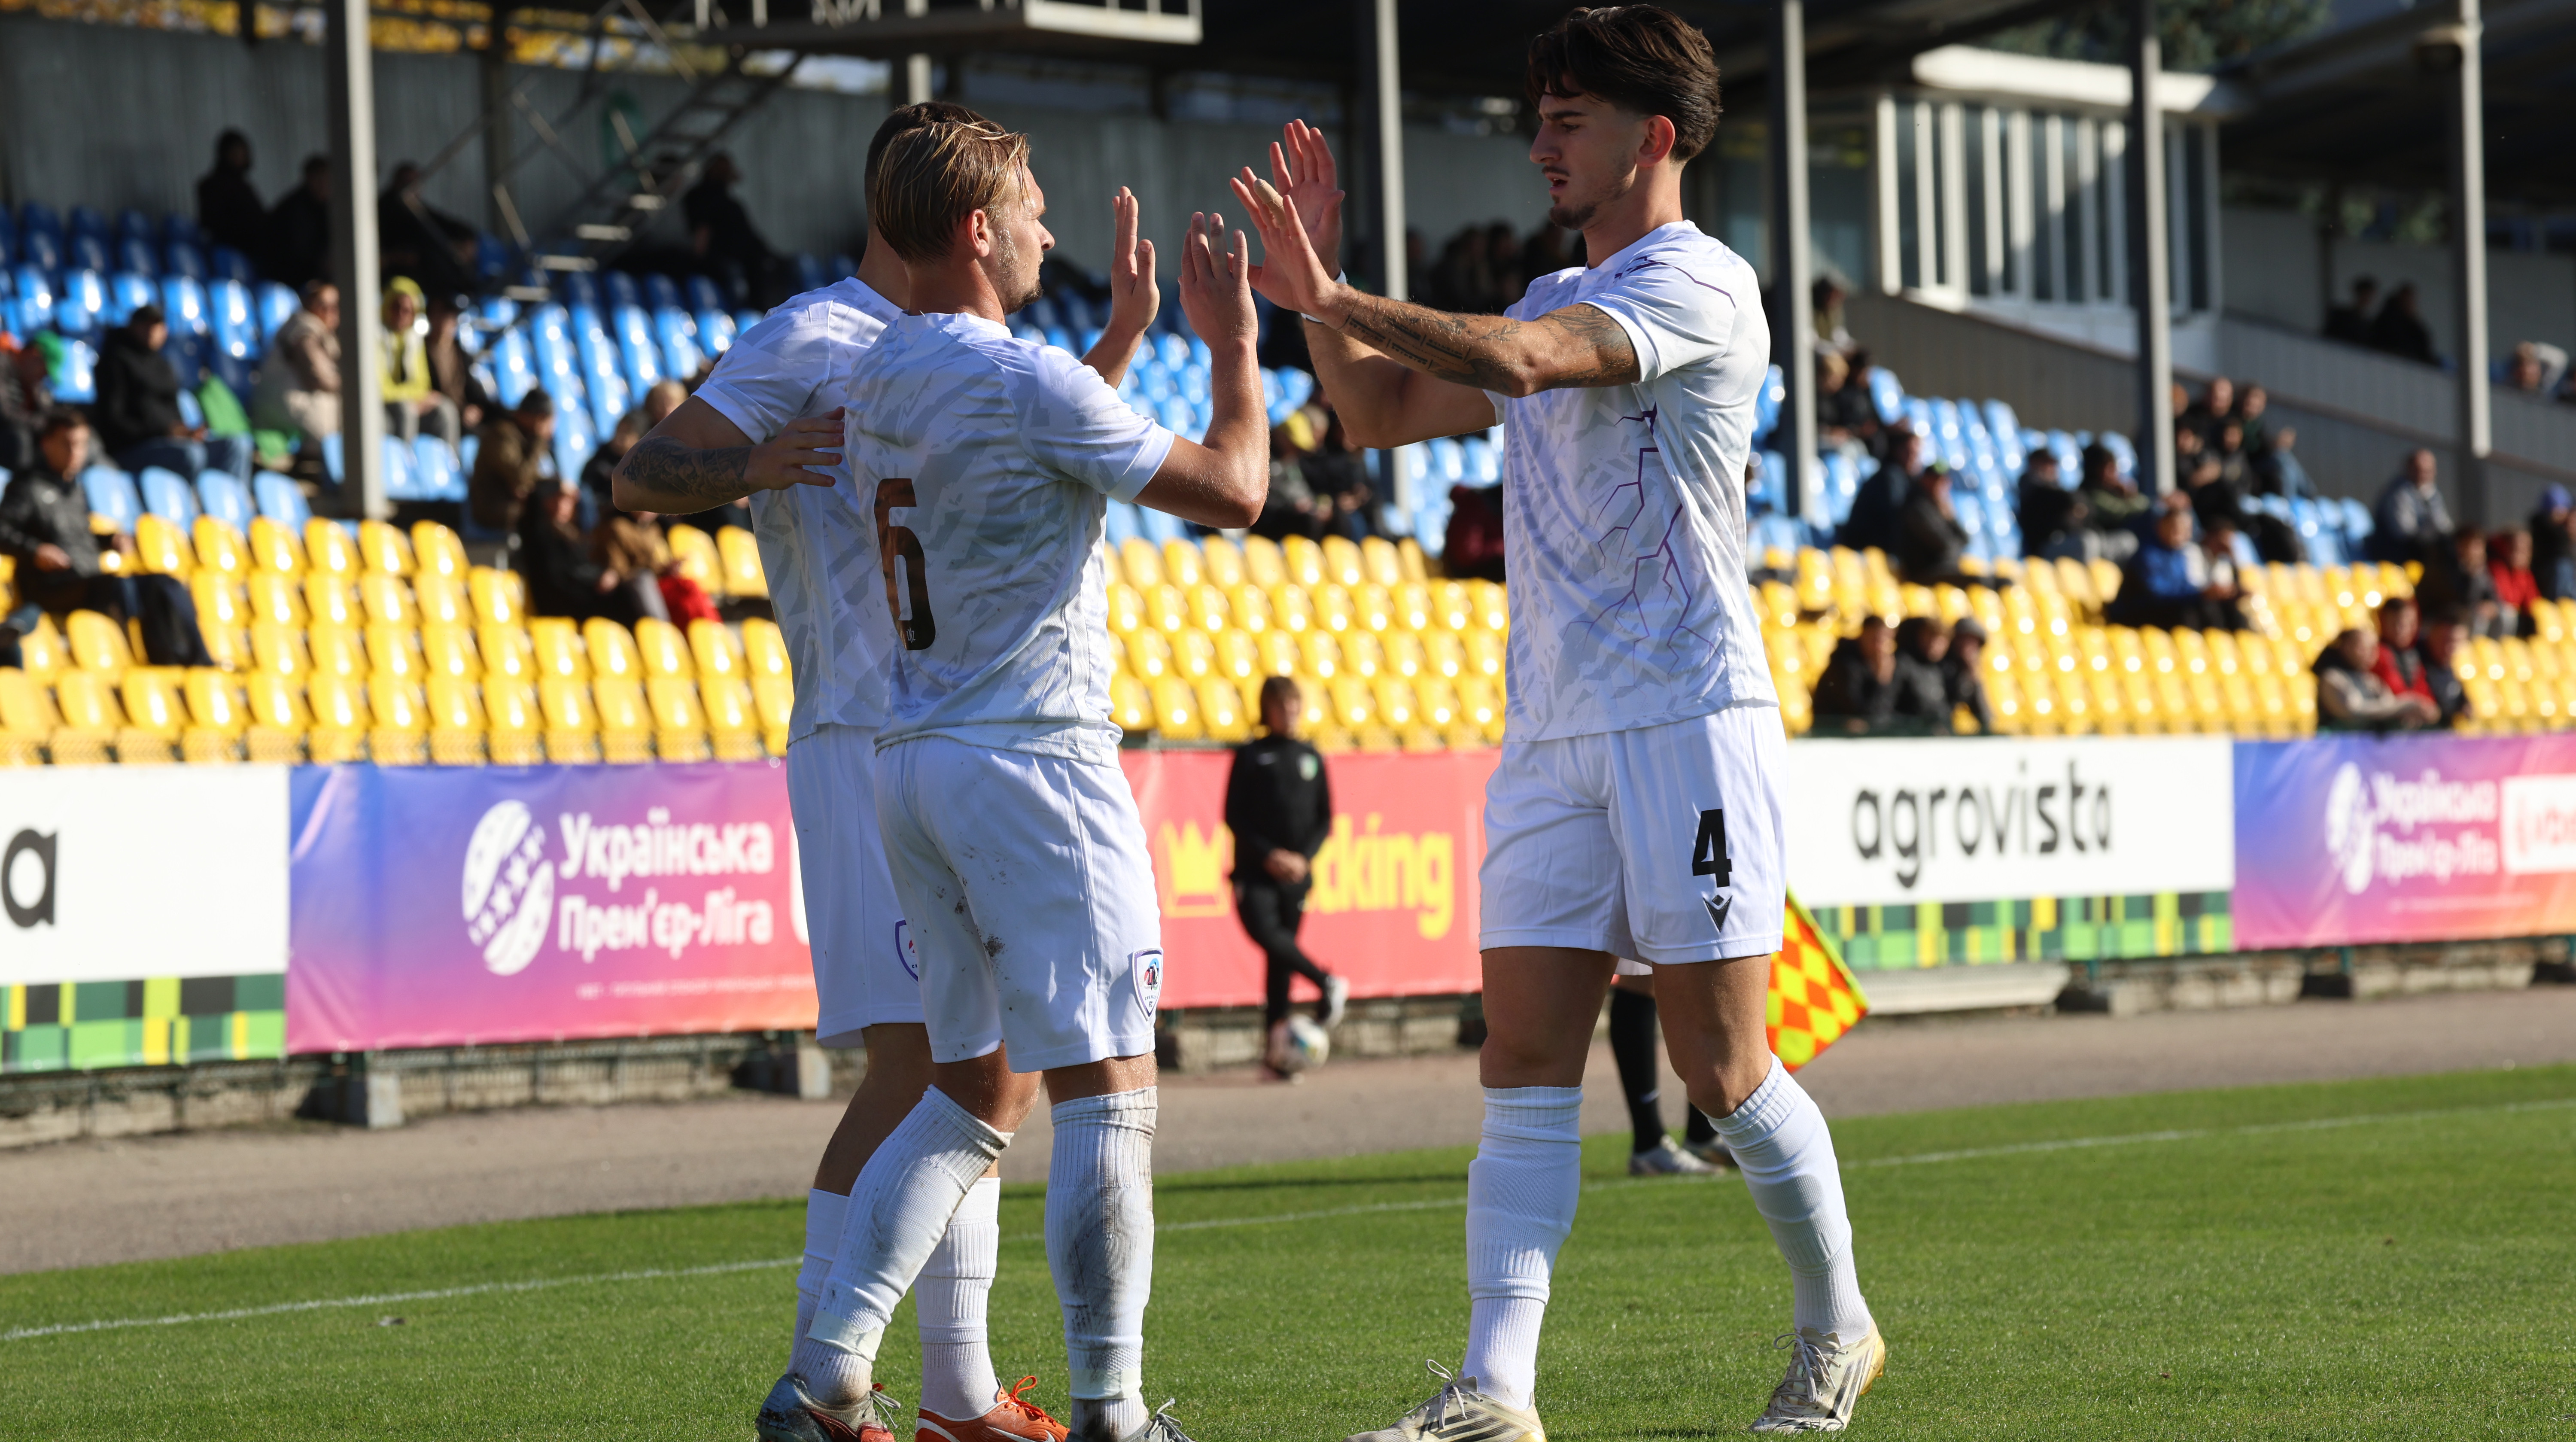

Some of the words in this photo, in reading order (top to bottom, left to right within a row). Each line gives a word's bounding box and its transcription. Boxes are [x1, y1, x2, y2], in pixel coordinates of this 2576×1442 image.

[874, 478, 936, 651] 6
[559, 806, 774, 892] Українська
[1692, 809, 1733, 888] 4
[1852, 759, 2111, 888] agrovista
